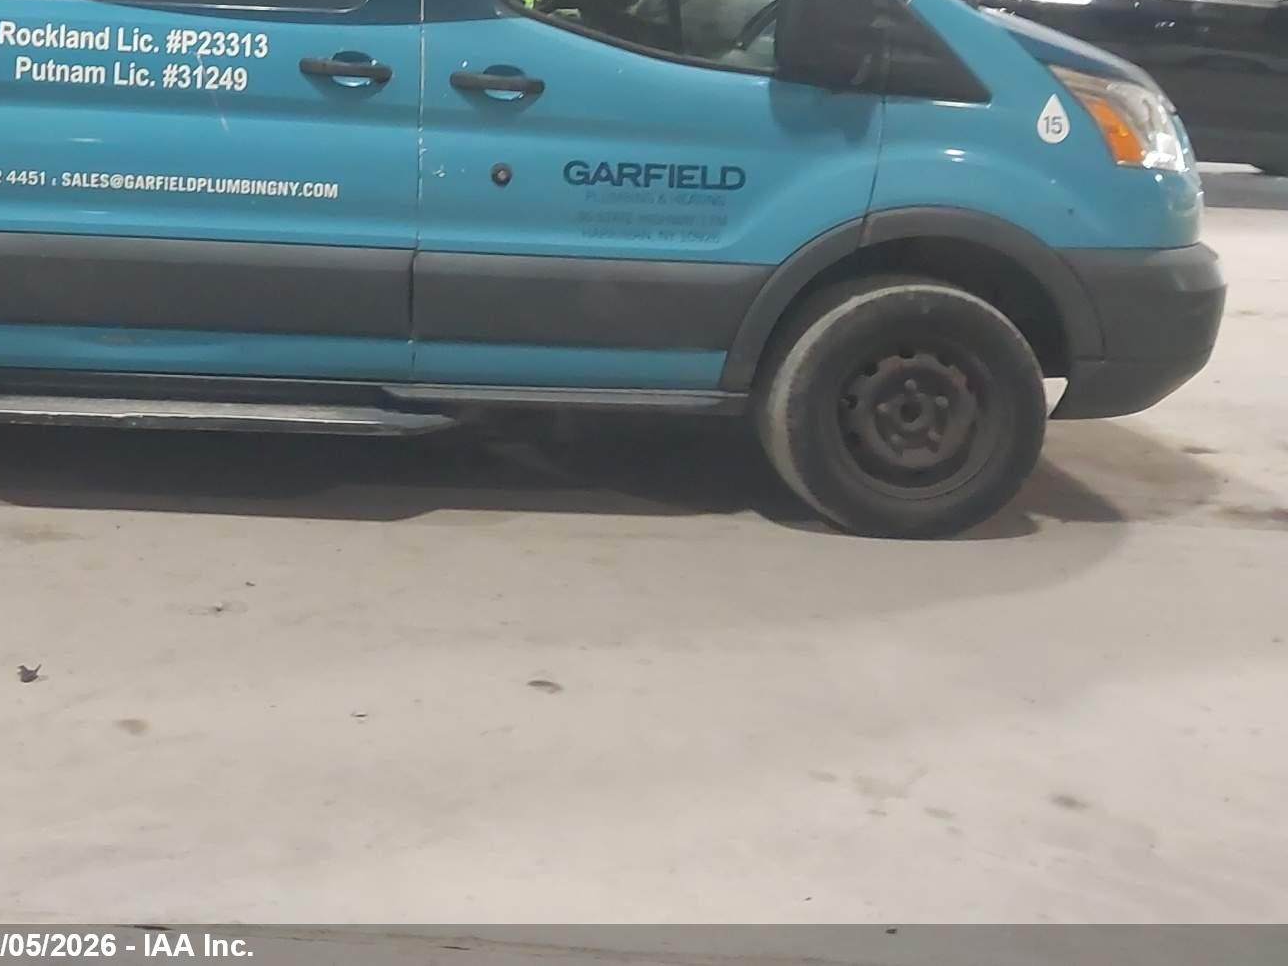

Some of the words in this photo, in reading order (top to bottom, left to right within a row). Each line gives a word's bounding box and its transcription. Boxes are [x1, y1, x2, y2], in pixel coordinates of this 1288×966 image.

[117, 27, 159, 53] Lic.
[166, 29, 269, 58] #P23313
[15, 56, 106, 84] Putnam
[113, 61, 156, 87] Lic.
[162, 63, 248, 91] #31249
[1043, 115, 1063, 134] 15
[6, 170, 46, 186] 4451
[62, 172, 339, 199] SALES@GARFIELDPLUMBINGNY.COM
[563, 160, 747, 191] GARFIELD
